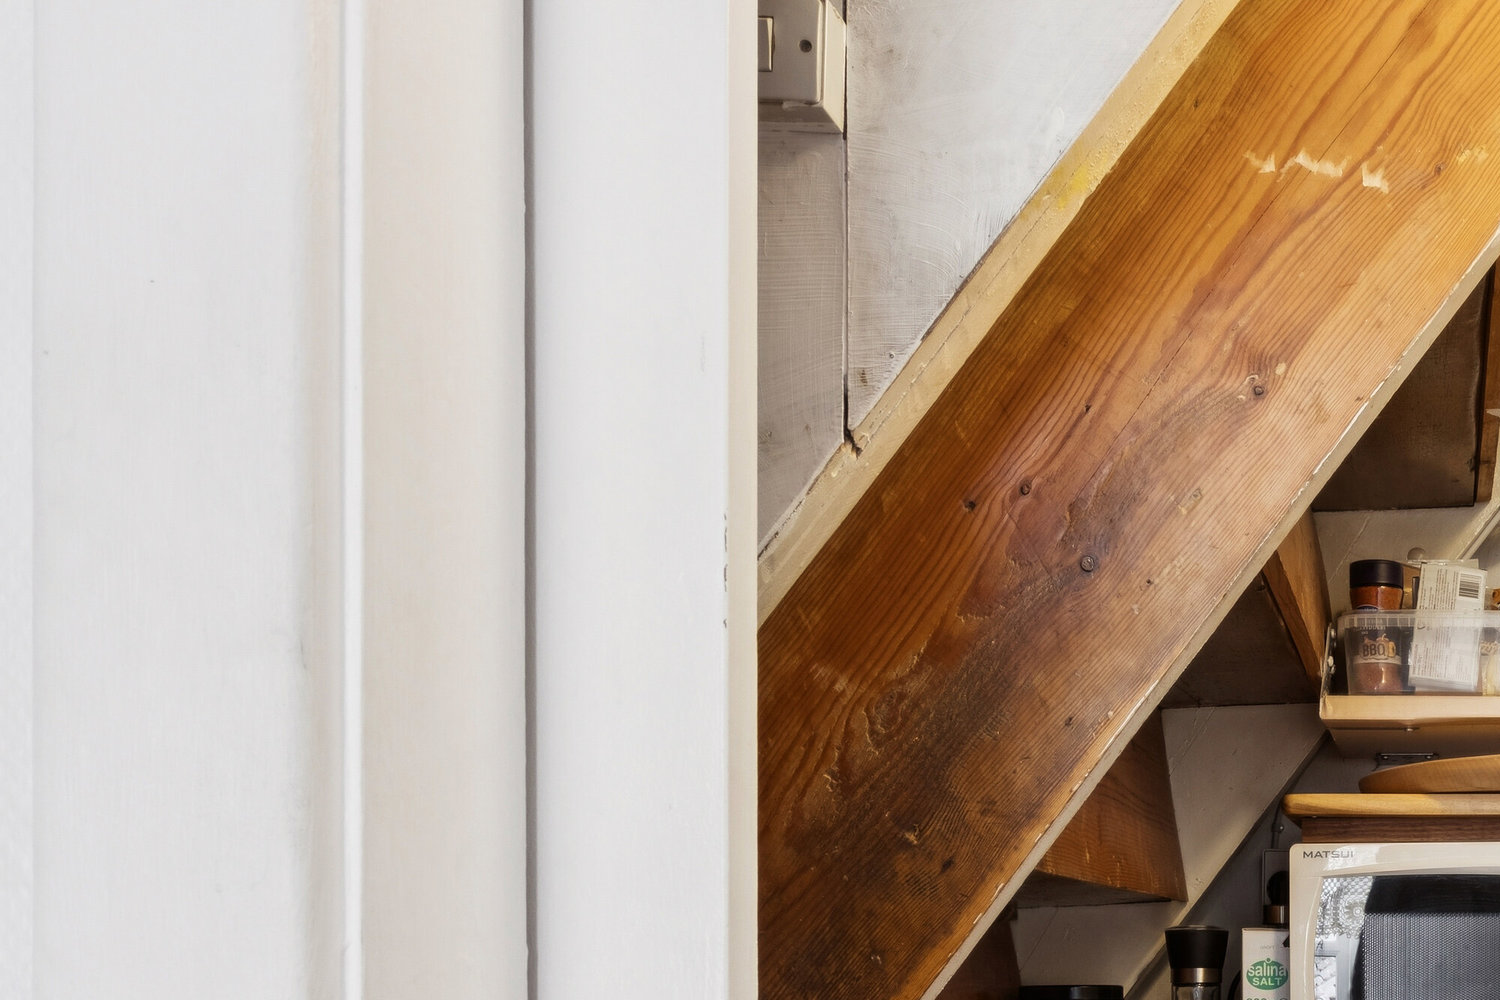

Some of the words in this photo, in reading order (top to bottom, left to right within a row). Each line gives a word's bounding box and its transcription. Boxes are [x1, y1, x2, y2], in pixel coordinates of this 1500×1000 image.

[1362, 643, 1386, 657] BBQ
[1303, 850, 1353, 859] MATSUI
[1248, 957, 1287, 977] salina
[1252, 977, 1282, 986] SALT
